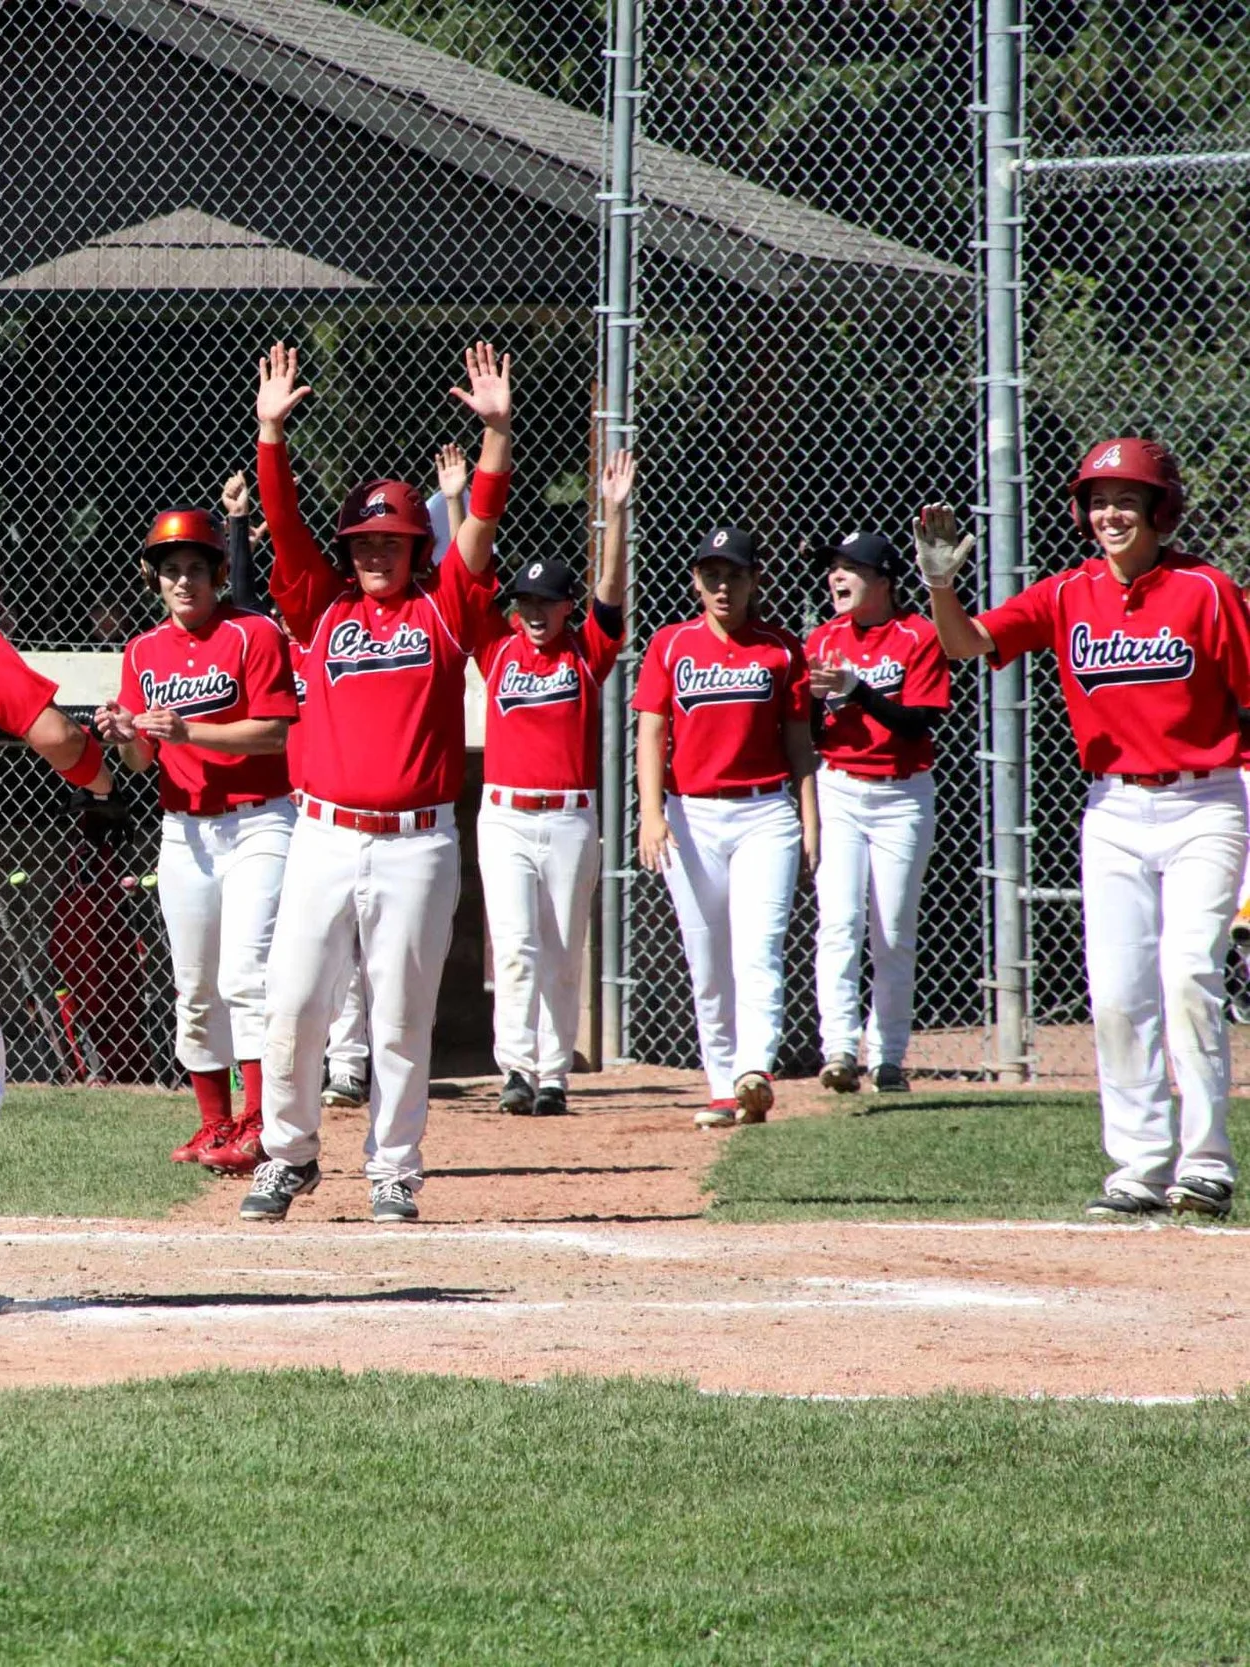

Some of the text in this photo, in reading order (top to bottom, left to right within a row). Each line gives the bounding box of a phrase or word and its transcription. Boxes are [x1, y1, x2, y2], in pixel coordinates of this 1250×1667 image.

[328, 619, 430, 657] Otario
[1071, 622, 1190, 670] Ontario
[501, 661, 580, 695] Ontario
[674, 656, 773, 693] Ontario
